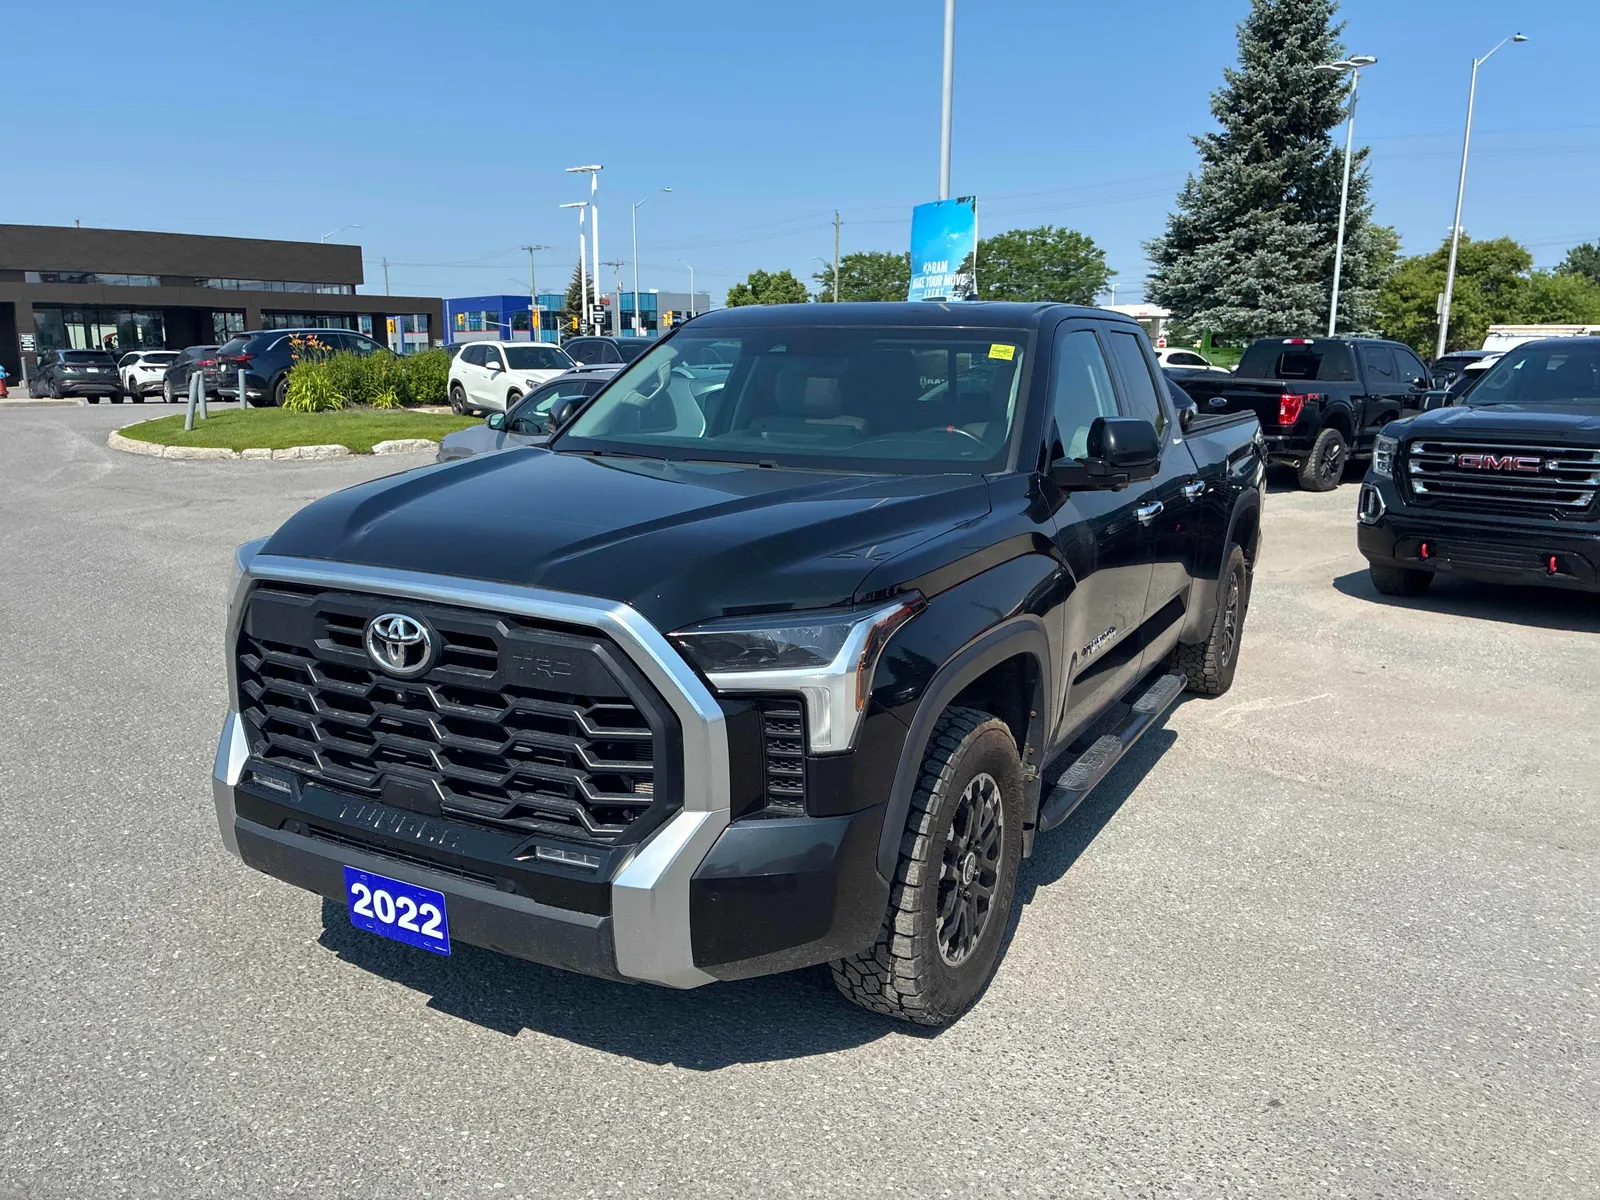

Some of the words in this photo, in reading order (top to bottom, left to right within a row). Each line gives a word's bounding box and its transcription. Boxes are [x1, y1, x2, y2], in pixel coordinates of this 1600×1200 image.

[932, 260, 948, 274] RAM
[926, 275, 943, 287] YOUR
[943, 273, 968, 286] MOVE
[1458, 453, 1540, 473] GMC
[511, 655, 572, 678] TRD
[351, 882, 444, 940] 2022
